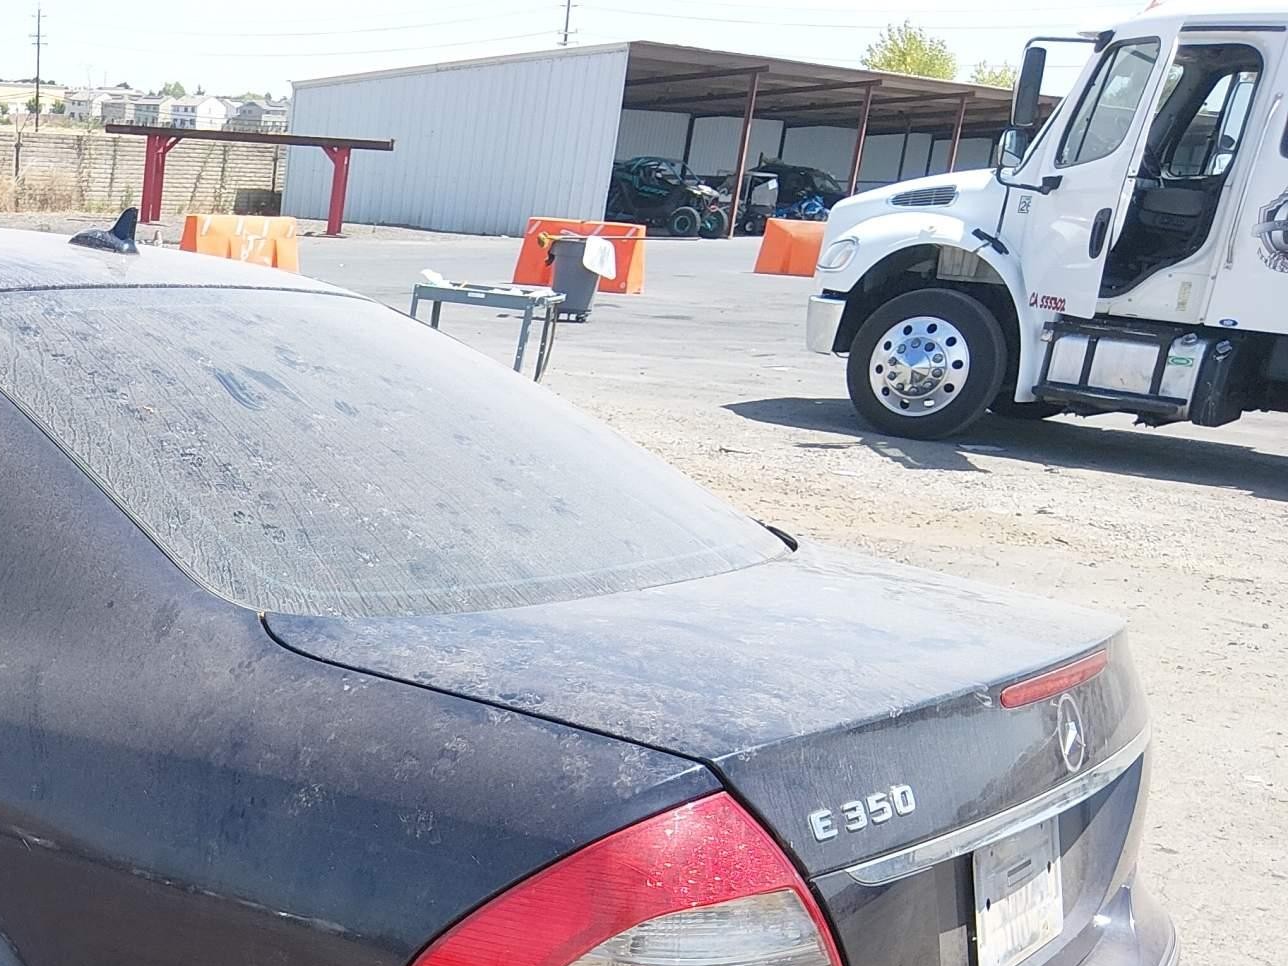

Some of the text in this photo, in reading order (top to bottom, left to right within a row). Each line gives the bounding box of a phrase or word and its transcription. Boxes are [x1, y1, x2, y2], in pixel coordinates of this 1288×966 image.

[1029, 292, 1039, 308] CA
[808, 784, 916, 842] E 350
